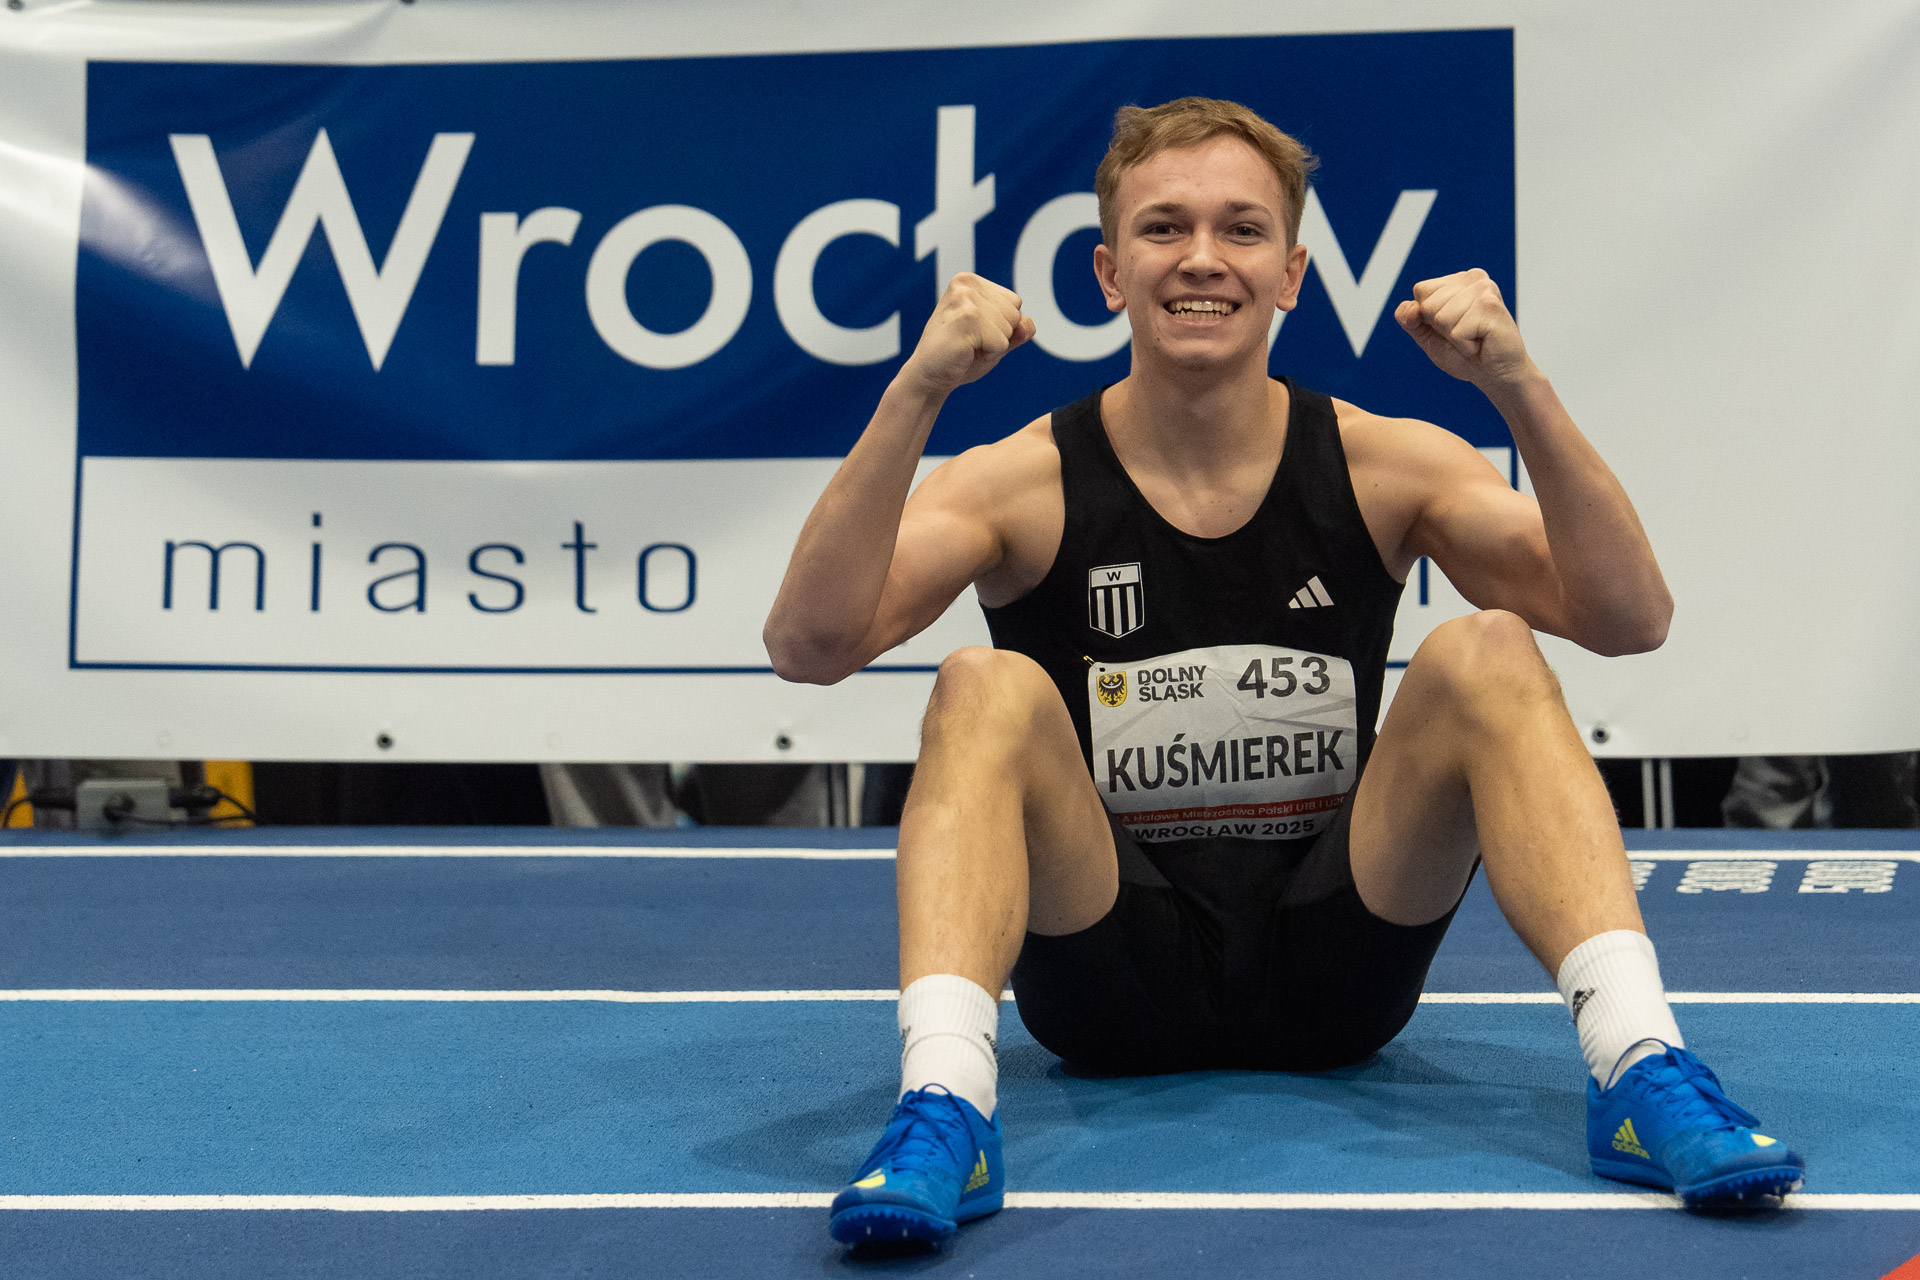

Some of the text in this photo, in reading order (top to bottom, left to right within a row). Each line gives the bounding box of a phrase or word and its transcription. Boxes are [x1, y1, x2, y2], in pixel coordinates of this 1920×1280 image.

[161, 512, 698, 614] miasto
[1106, 570, 1122, 582] W
[1137, 665, 1207, 685] DOLNY
[1236, 656, 1331, 698] 453
[1138, 682, 1205, 702] ŚLĄSK
[1107, 730, 1345, 793] KUŚMIEREK
[1182, 807, 1255, 819] Mistrzostwa
[1258, 804, 1293, 815] Polski
[1134, 819, 1315, 839] WROCŁAW 2025
